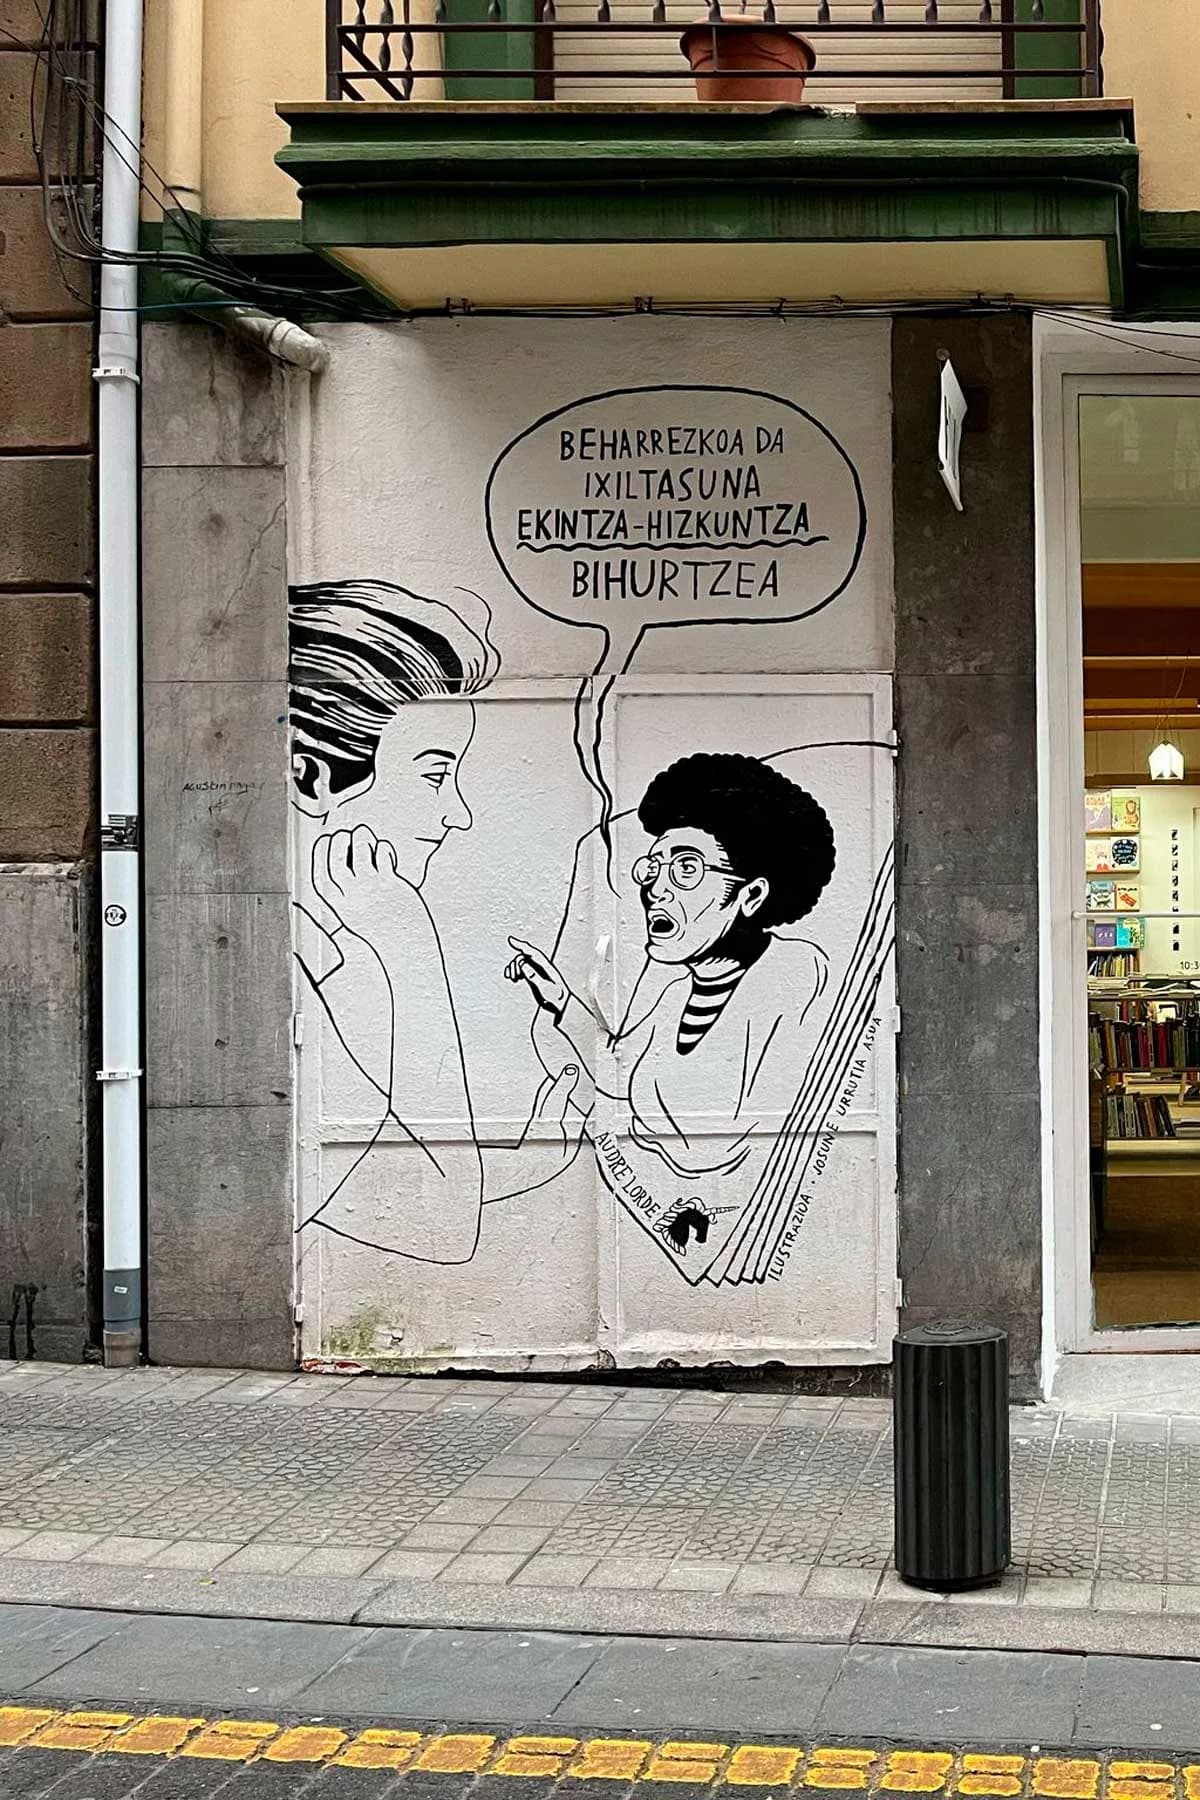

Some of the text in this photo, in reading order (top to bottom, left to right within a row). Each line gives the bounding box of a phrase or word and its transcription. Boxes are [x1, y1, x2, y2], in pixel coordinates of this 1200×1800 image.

[560, 426, 785, 461] BEHARREZKOA DA
[585, 466, 761, 501] IXILTASUNA
[518, 503, 809, 540] EKINTZA-HIZKUNTZA
[572, 559, 778, 600] BIHURTZEA
[768, 1017, 882, 1282] ILUSTRAZIOA JOSUNE URRUTIA ASUA
[594, 1131, 661, 1219] AUDRE LORDE
